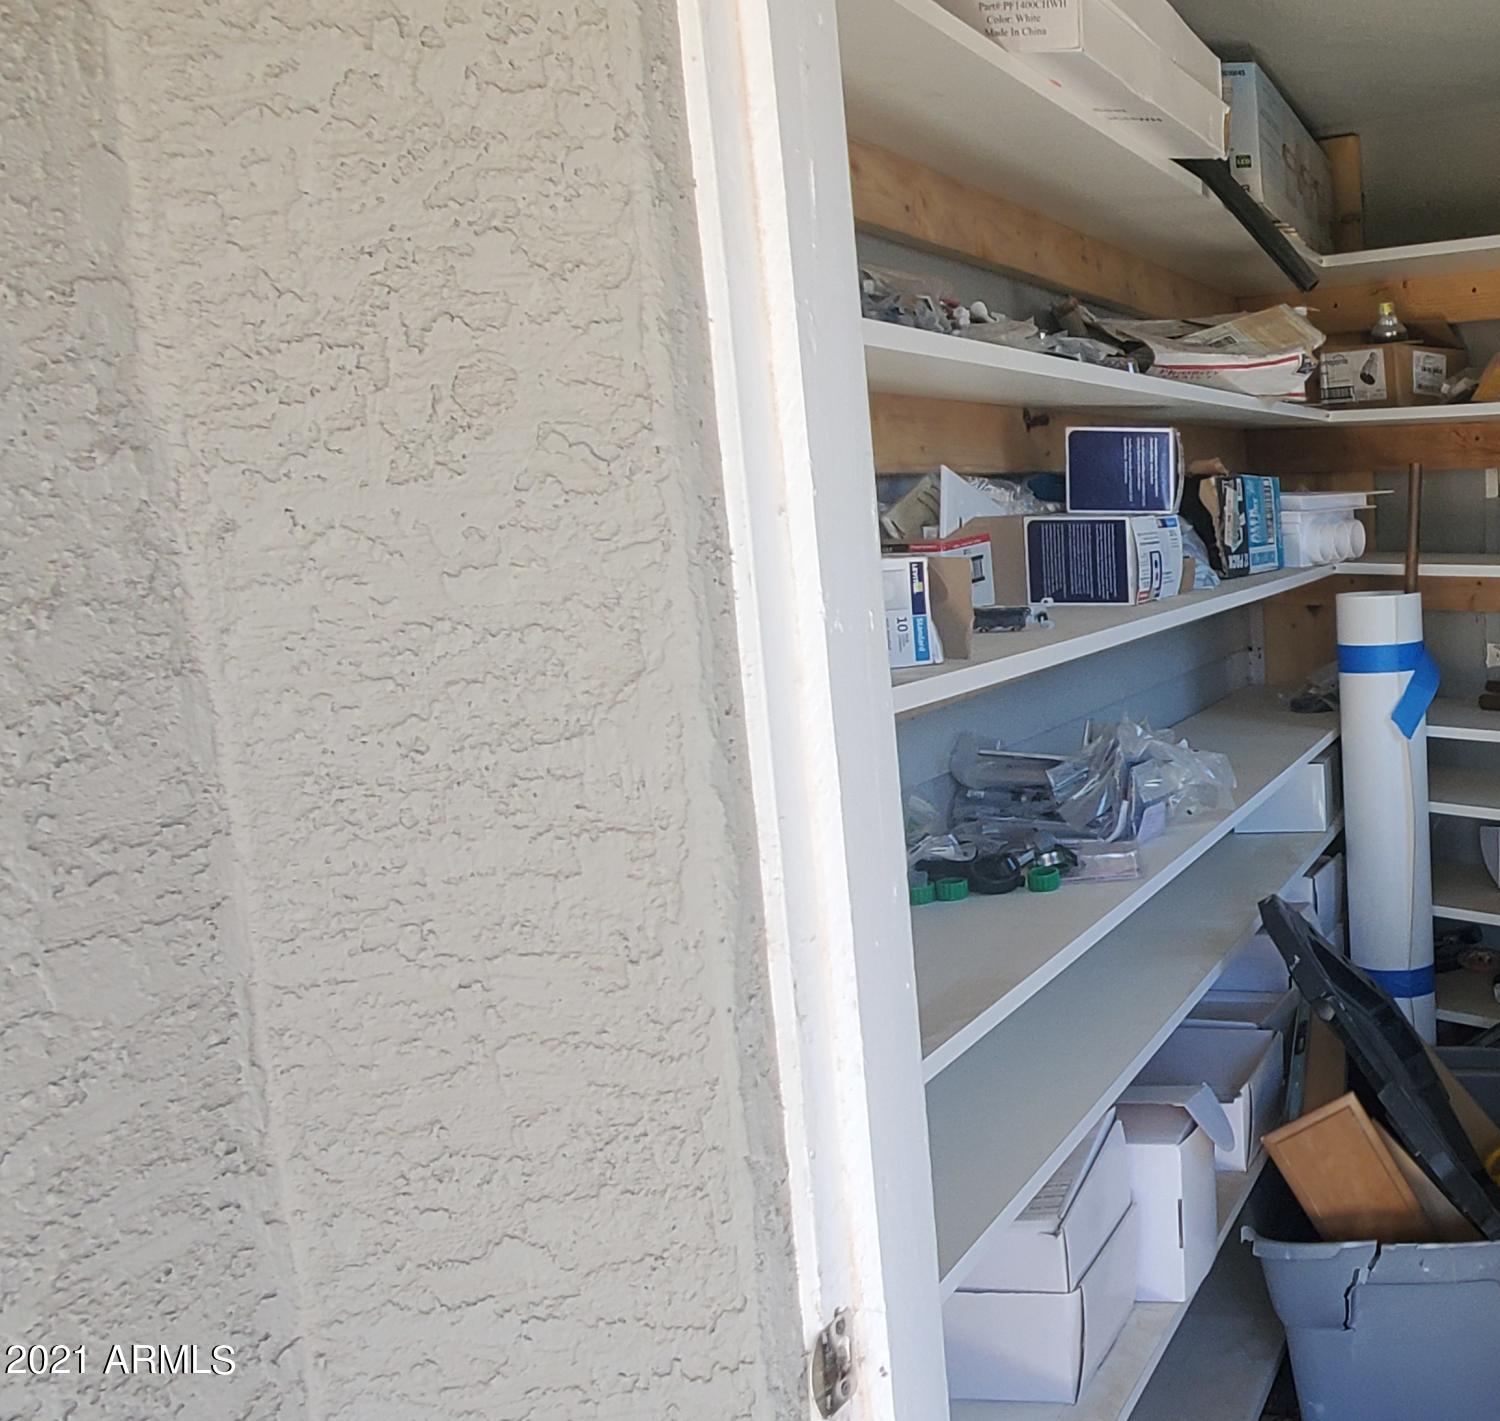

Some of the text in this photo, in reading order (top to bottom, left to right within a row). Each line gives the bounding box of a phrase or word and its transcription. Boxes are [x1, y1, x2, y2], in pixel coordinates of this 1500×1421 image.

[1015, 13, 1041, 23] White
[984, 27, 1047, 37] Made In China
[897, 617, 909, 632] 10
